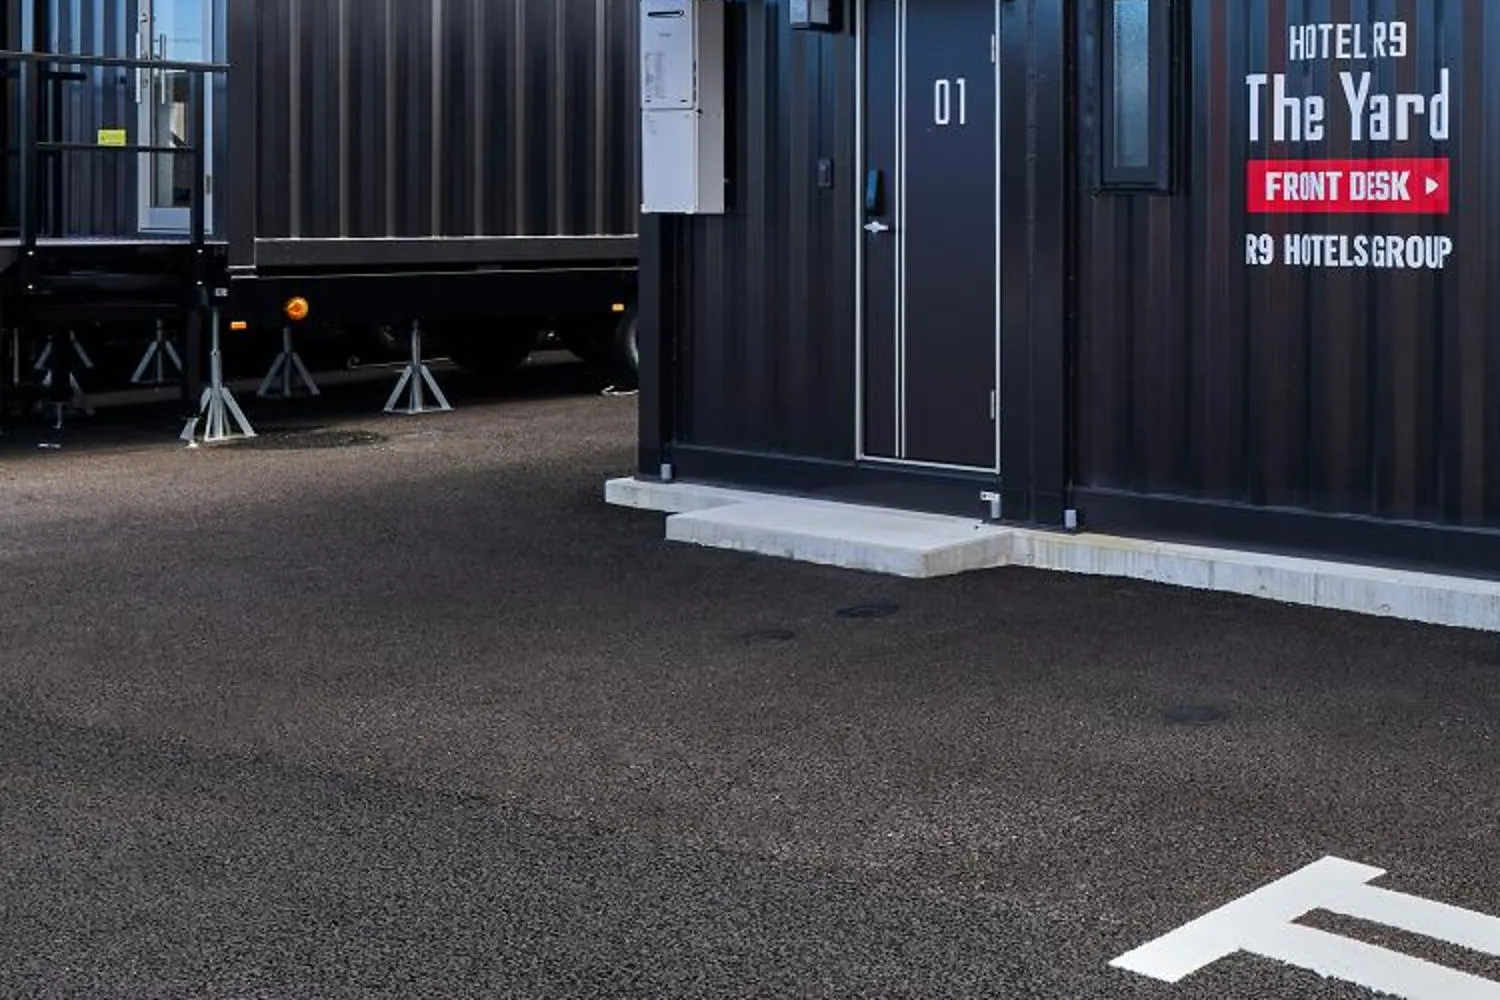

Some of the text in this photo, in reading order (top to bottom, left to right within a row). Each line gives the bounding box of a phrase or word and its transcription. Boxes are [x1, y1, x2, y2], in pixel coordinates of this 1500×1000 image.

[1289, 21, 1407, 60] HOTEL R9
[934, 78, 965, 125] 01
[1245, 67, 1449, 142] The Yard
[1264, 171, 1411, 201] FRONT DESK
[1245, 233, 1274, 266] R9
